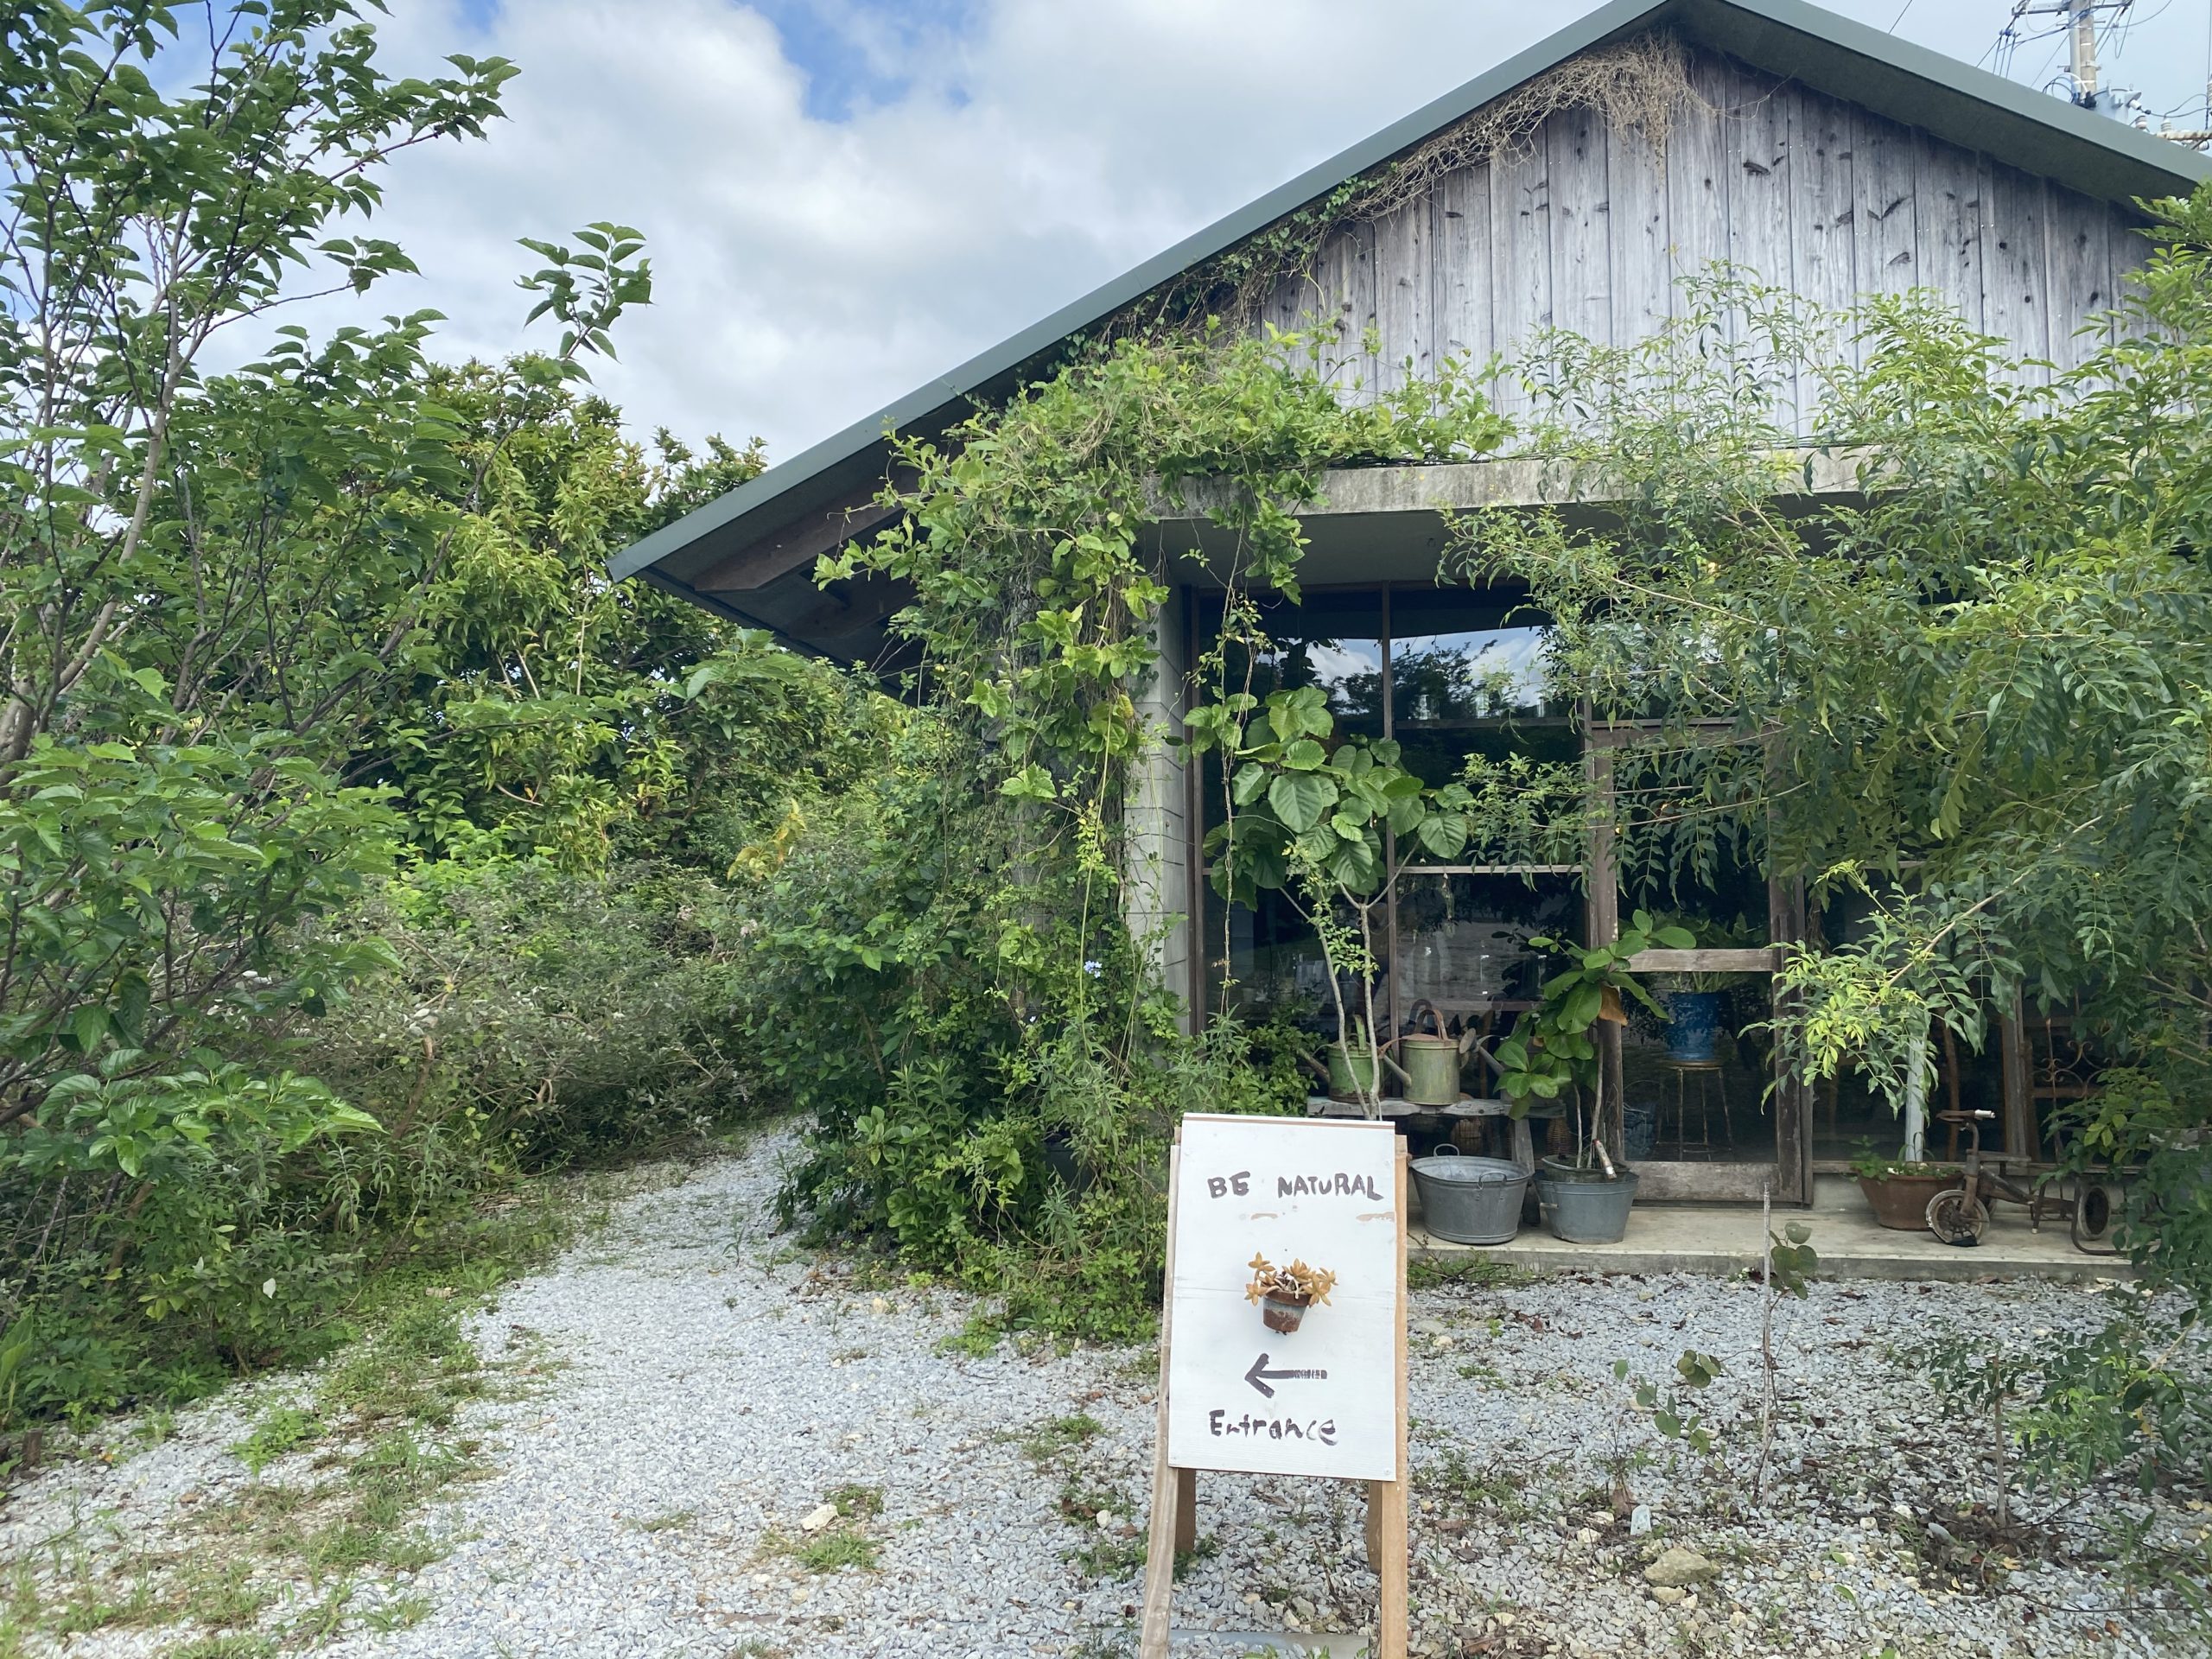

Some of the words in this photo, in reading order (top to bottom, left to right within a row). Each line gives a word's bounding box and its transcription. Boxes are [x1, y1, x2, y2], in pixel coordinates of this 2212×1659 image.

[1207, 1171, 1250, 1199] BE
[1277, 1173, 1384, 1201] NATURAL
[1209, 1409, 1338, 1446] Entrance
